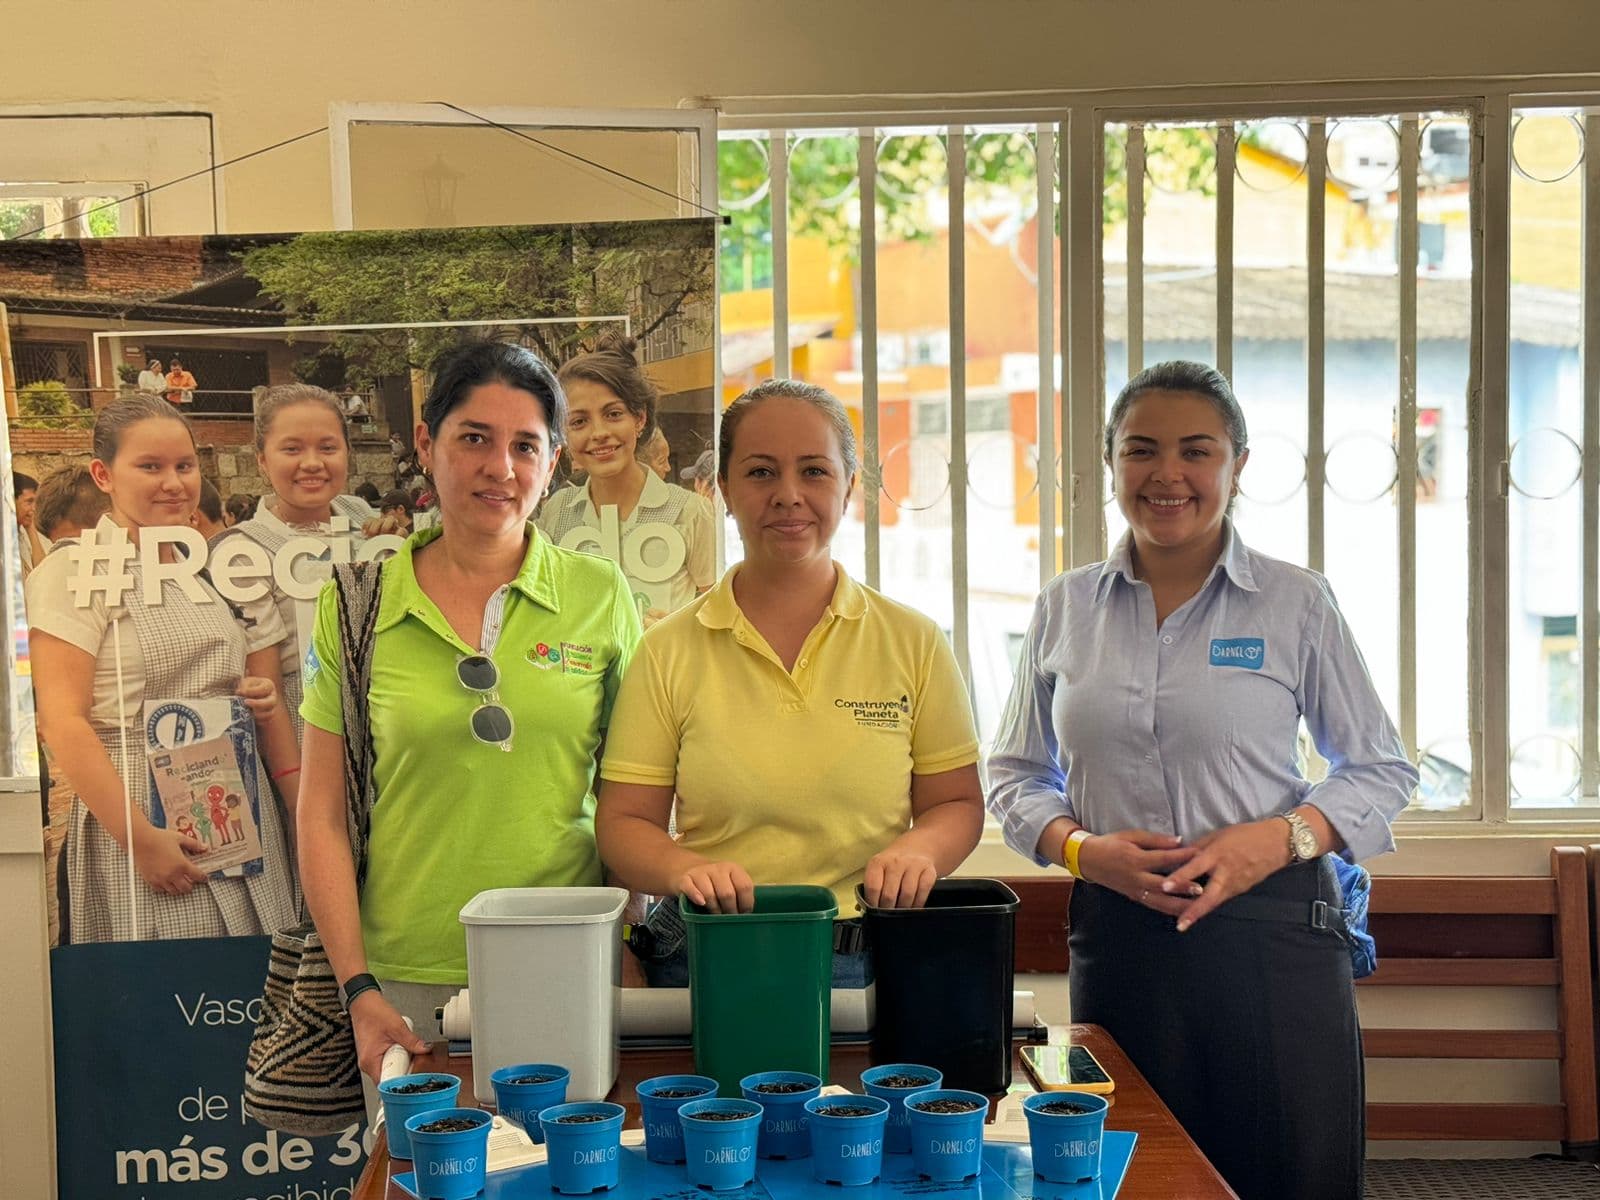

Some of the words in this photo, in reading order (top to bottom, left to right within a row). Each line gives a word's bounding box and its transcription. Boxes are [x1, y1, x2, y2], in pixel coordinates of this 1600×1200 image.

[854, 709, 899, 719] Planeta
[178, 1086, 229, 1122] de
[766, 1119, 797, 1134] DARNEL
[841, 1142, 872, 1158] DARNEL
[930, 1140, 963, 1155] DARNEL
[1055, 1142, 1087, 1158] DARNEL
[116, 1134, 228, 1184] más
[241, 1130, 314, 1176] de
[573, 1149, 606, 1165] DARNEL
[705, 1149, 738, 1164] DARNEL
[429, 1160, 463, 1176] DARNEL
